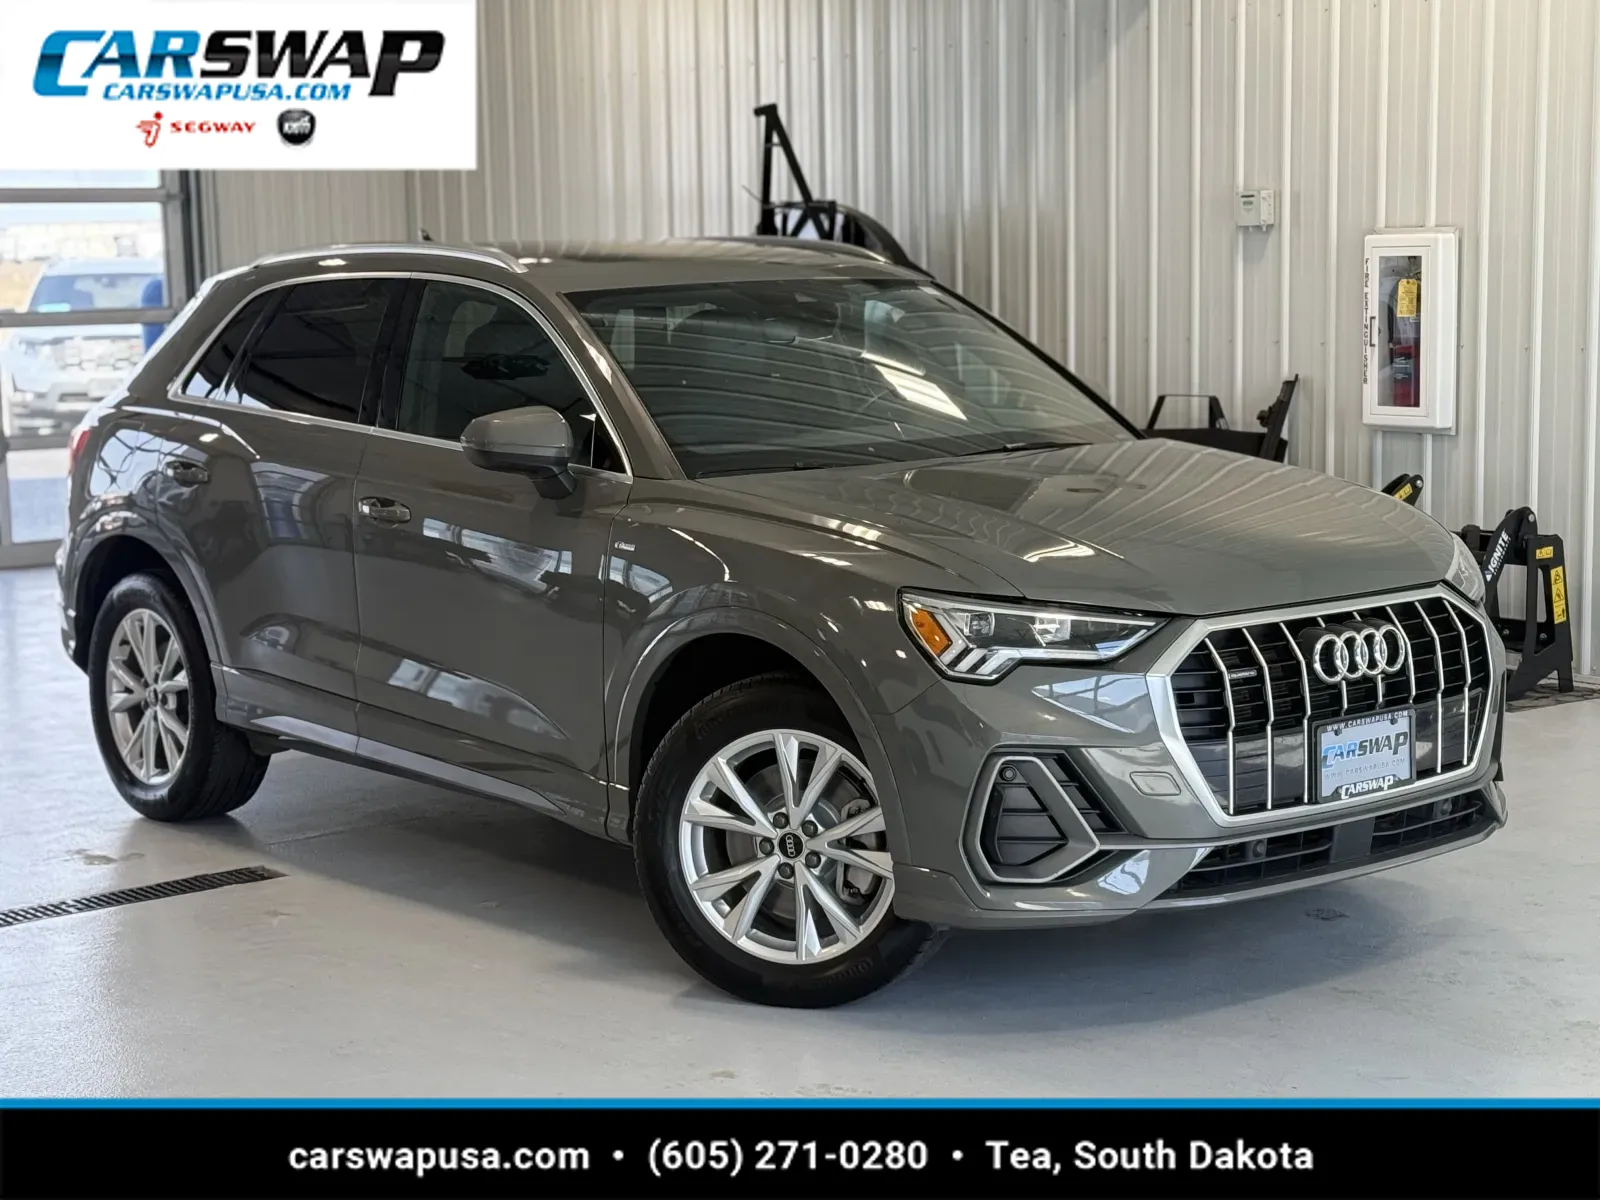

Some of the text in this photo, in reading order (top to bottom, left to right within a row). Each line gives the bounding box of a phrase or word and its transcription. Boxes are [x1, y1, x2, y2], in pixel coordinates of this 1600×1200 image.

[1488, 530, 1509, 573] IGNITE
[1326, 710, 1408, 732] WWW.CARSWAPUSA.COM
[1321, 731, 1409, 769] CARSWAP
[1341, 775, 1394, 800] CARSWAP
